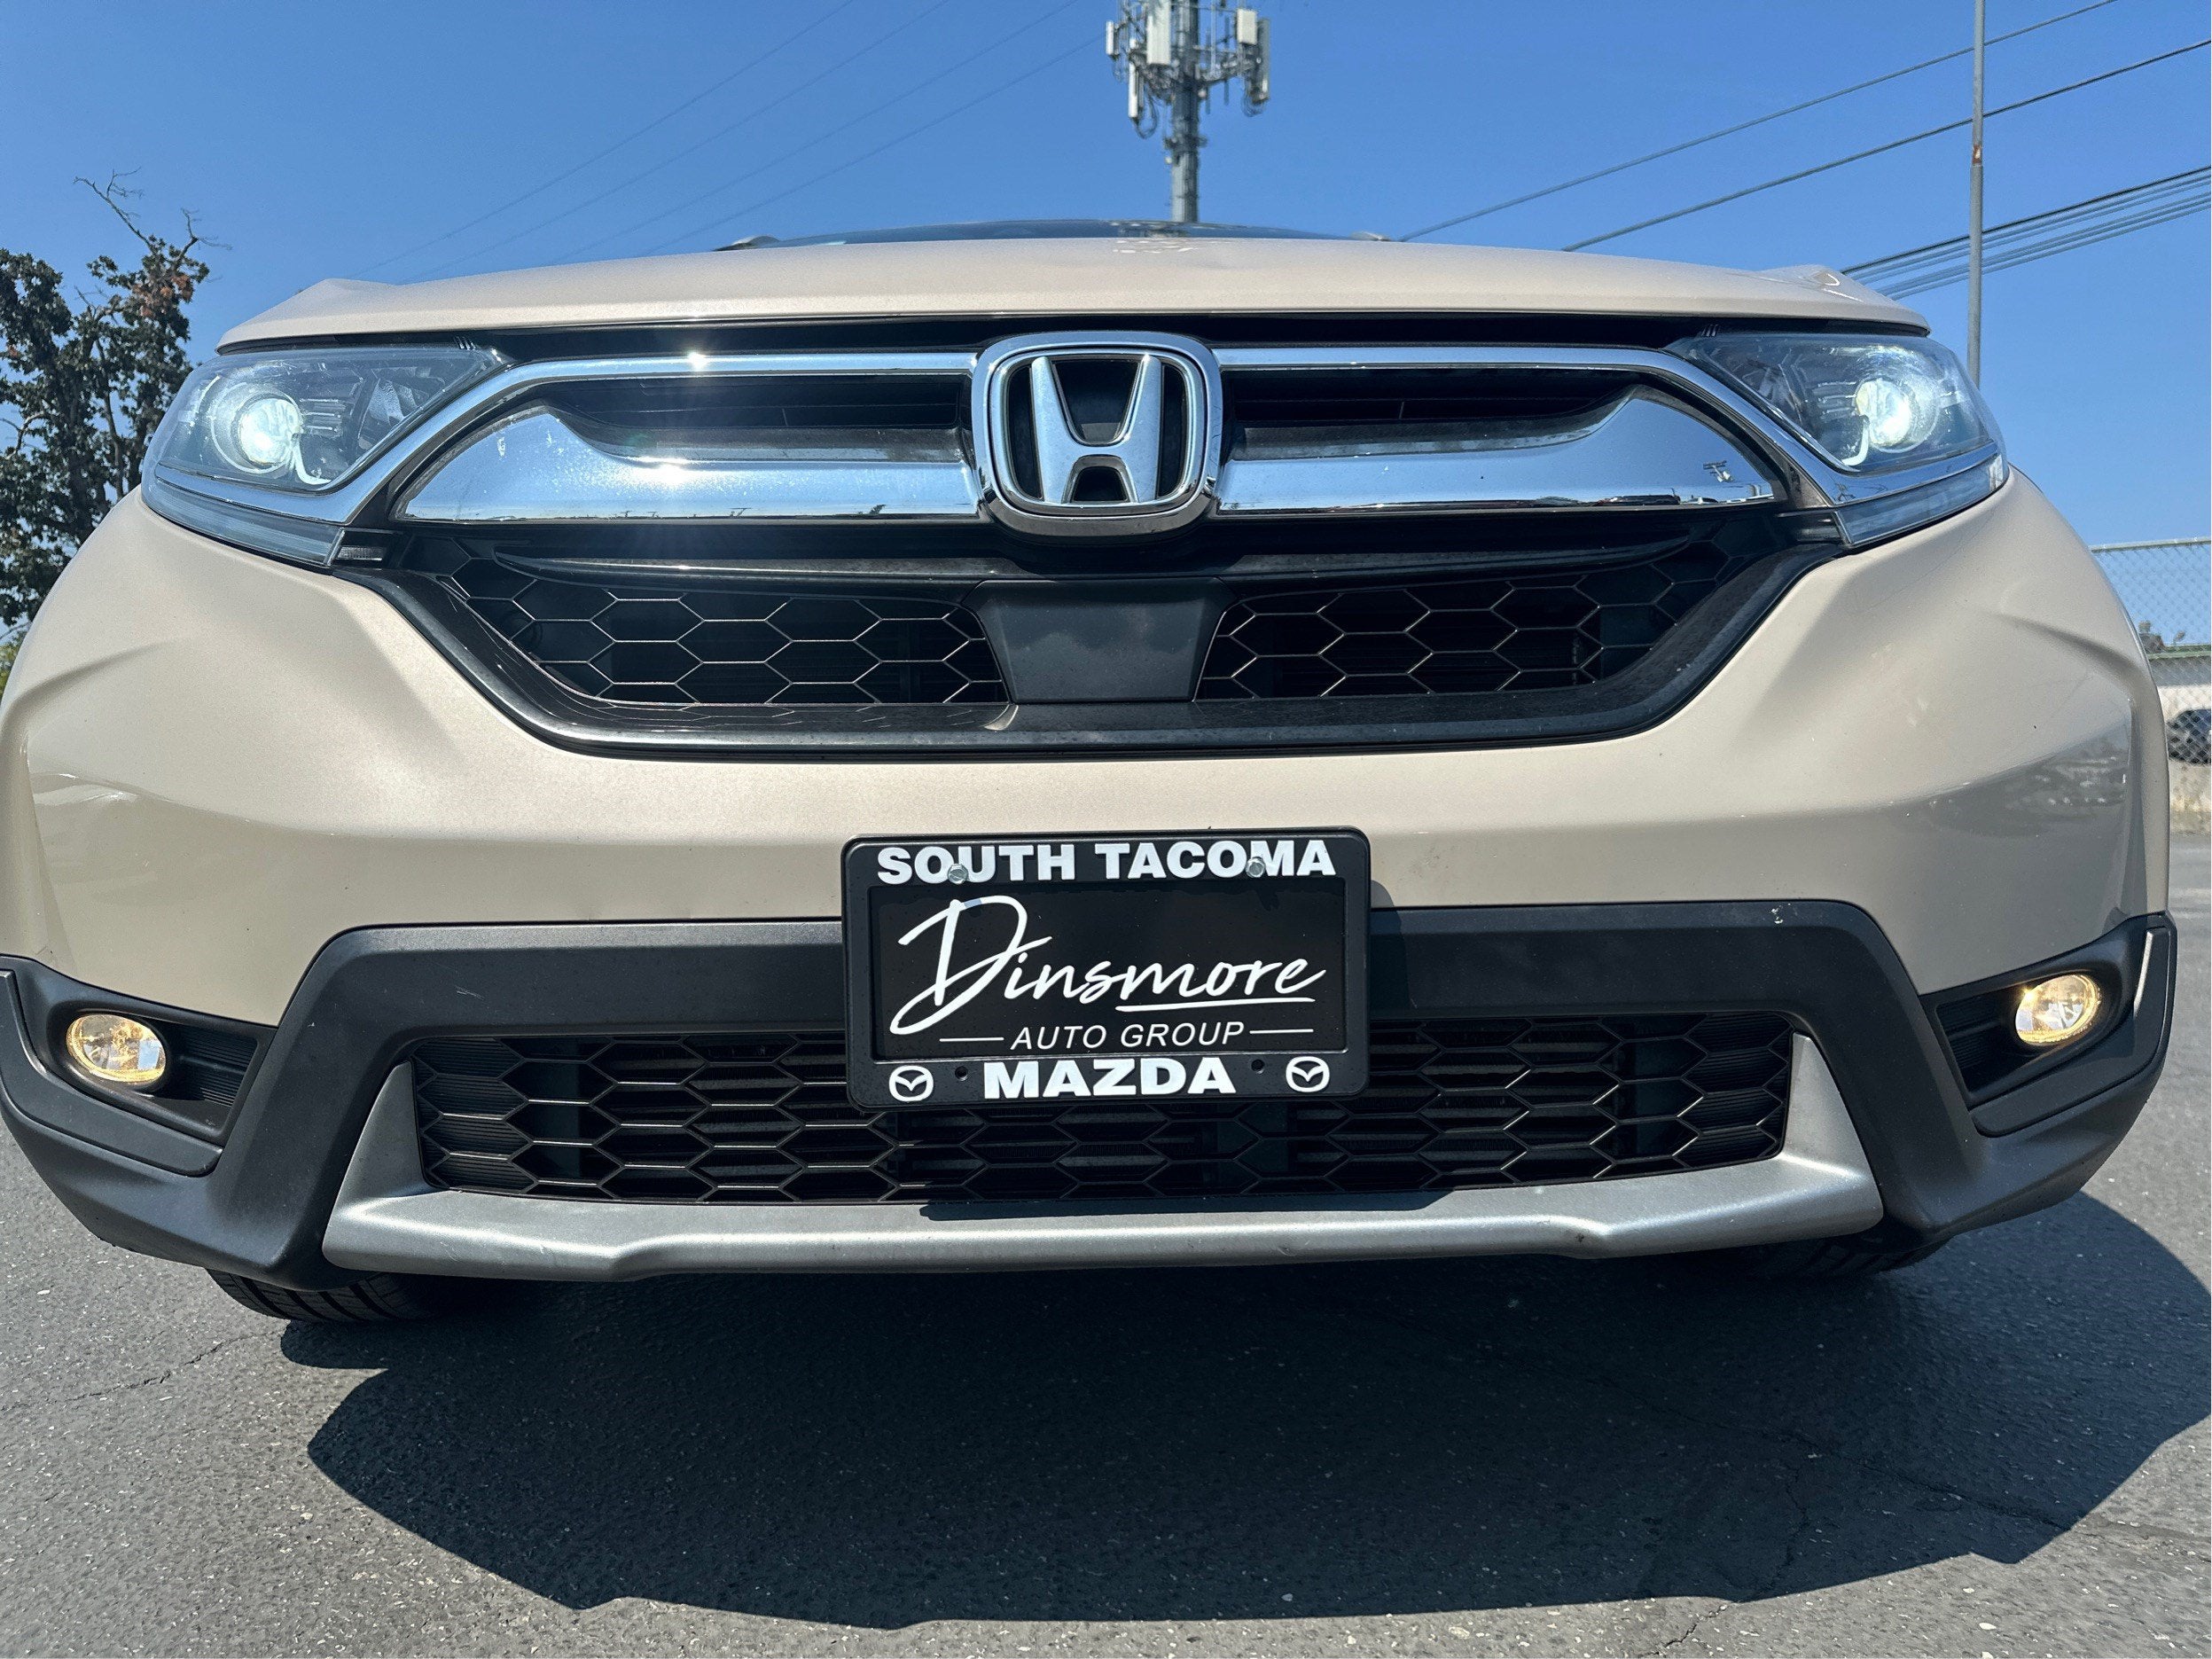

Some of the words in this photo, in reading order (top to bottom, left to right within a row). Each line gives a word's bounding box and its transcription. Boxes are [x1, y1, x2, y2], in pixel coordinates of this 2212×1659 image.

[877, 843, 1075, 885] SOUTH
[1094, 839, 1336, 880] TACOMA
[889, 895, 1325, 1035] Dinsmore
[1011, 1026, 1106, 1050] AUTO
[1120, 1021, 1244, 1047] GROUP
[983, 1057, 1236, 1099] MAZDA
